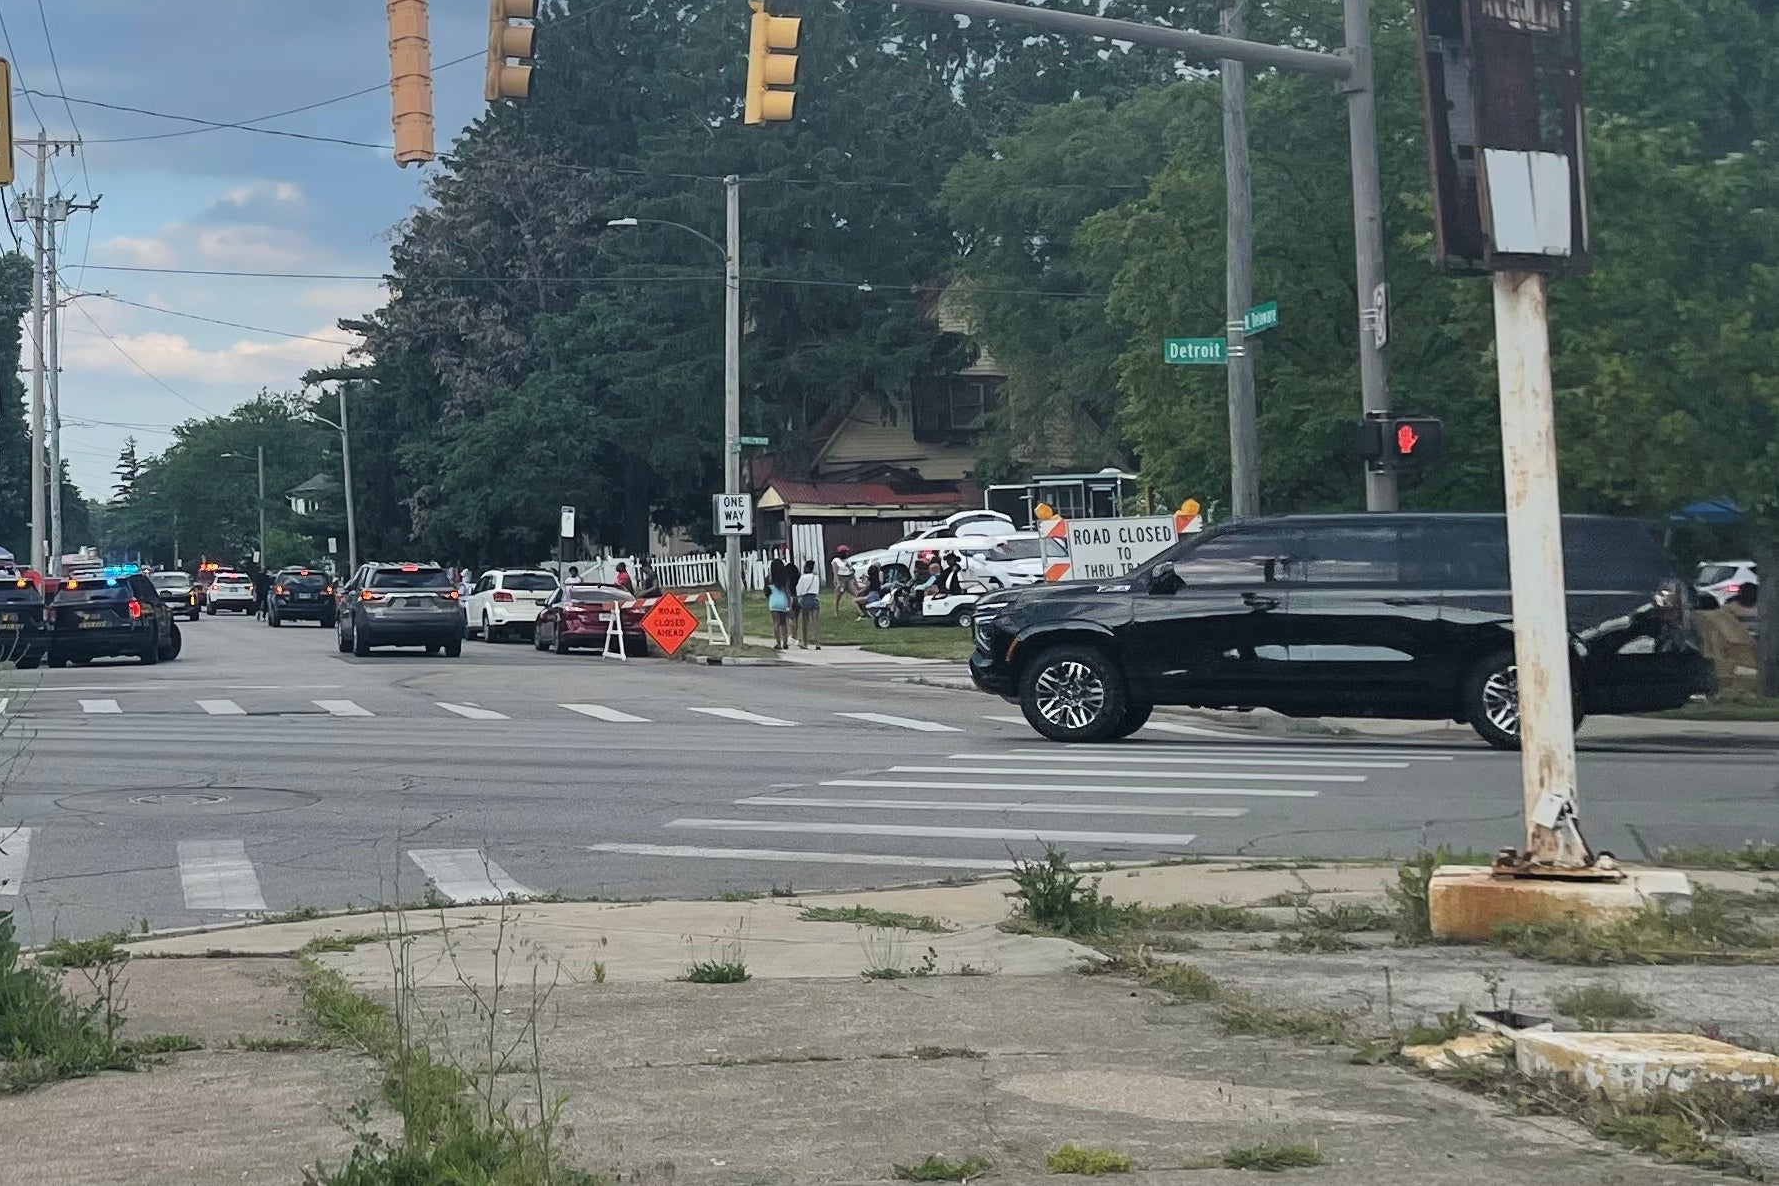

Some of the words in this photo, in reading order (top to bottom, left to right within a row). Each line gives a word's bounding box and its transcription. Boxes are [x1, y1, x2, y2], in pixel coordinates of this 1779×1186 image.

[1170, 343, 1221, 359] Detroit
[724, 497, 744, 507] ONE
[724, 510, 745, 521] WAY
[1073, 528, 1111, 545] ROAD
[1119, 526, 1172, 543] CLOSED
[1117, 547, 1132, 560] TO
[1085, 564, 1114, 579] THRU
[654, 619, 686, 627] CLOSED
[657, 629, 684, 637] AHEAD
